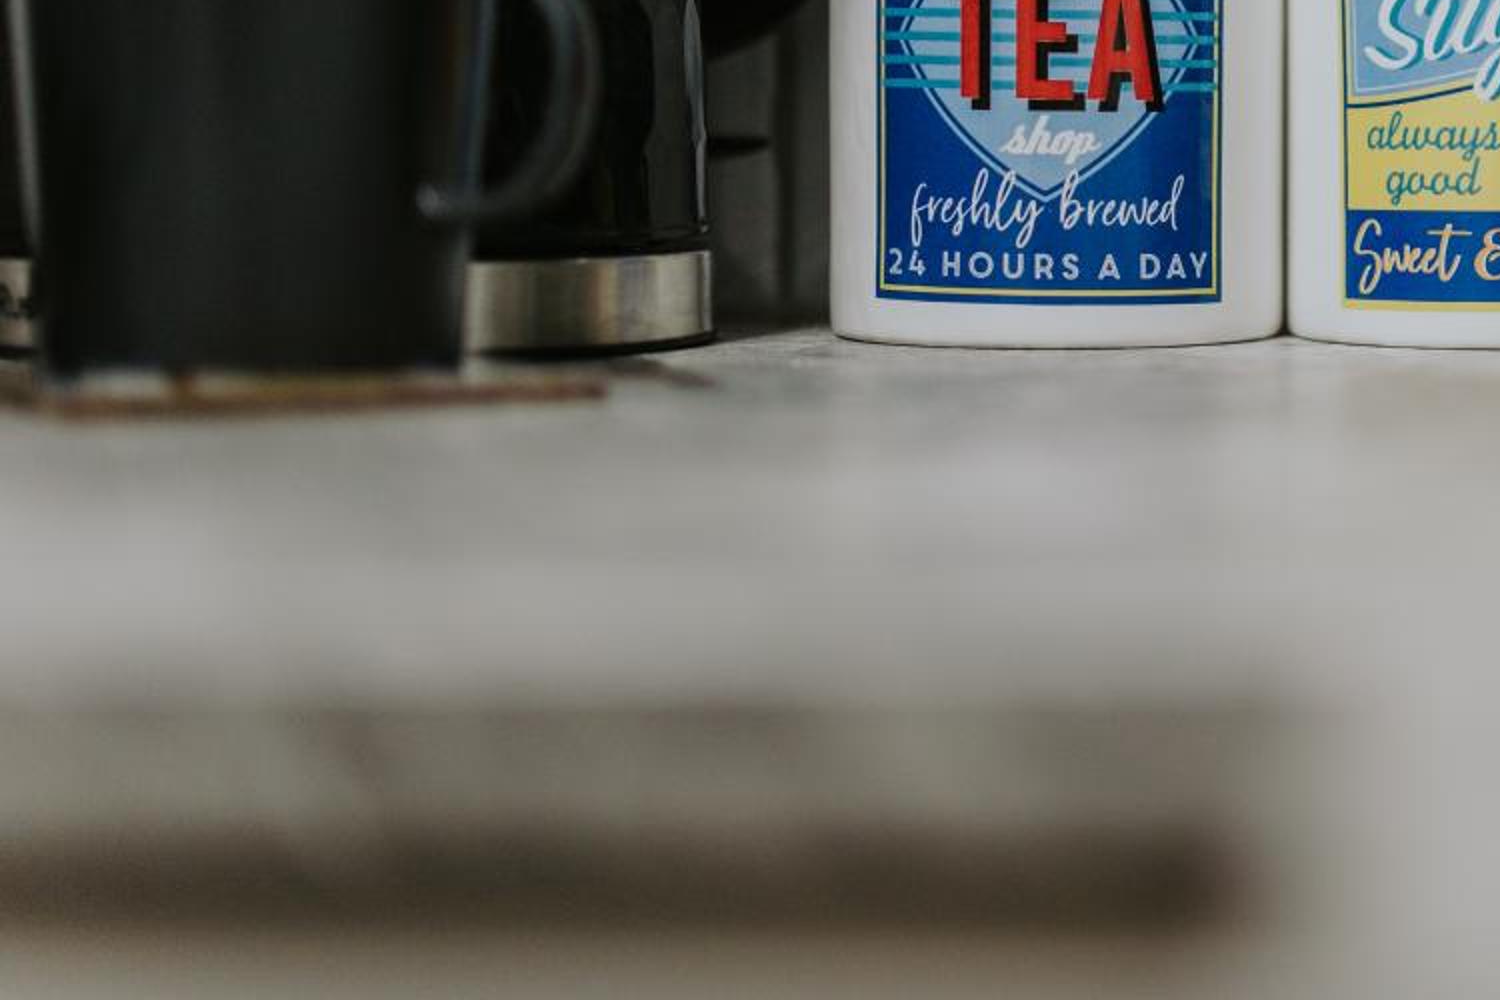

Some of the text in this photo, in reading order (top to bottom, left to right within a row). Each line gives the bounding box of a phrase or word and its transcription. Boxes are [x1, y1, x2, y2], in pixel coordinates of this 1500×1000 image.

[999, 115, 1101, 164] shop
[1385, 157, 1481, 205] good
[909, 170, 1185, 248] freshly brewed
[888, 248, 1208, 280] 24 HOURS A DAY
[1353, 218, 1472, 295] Sweet
